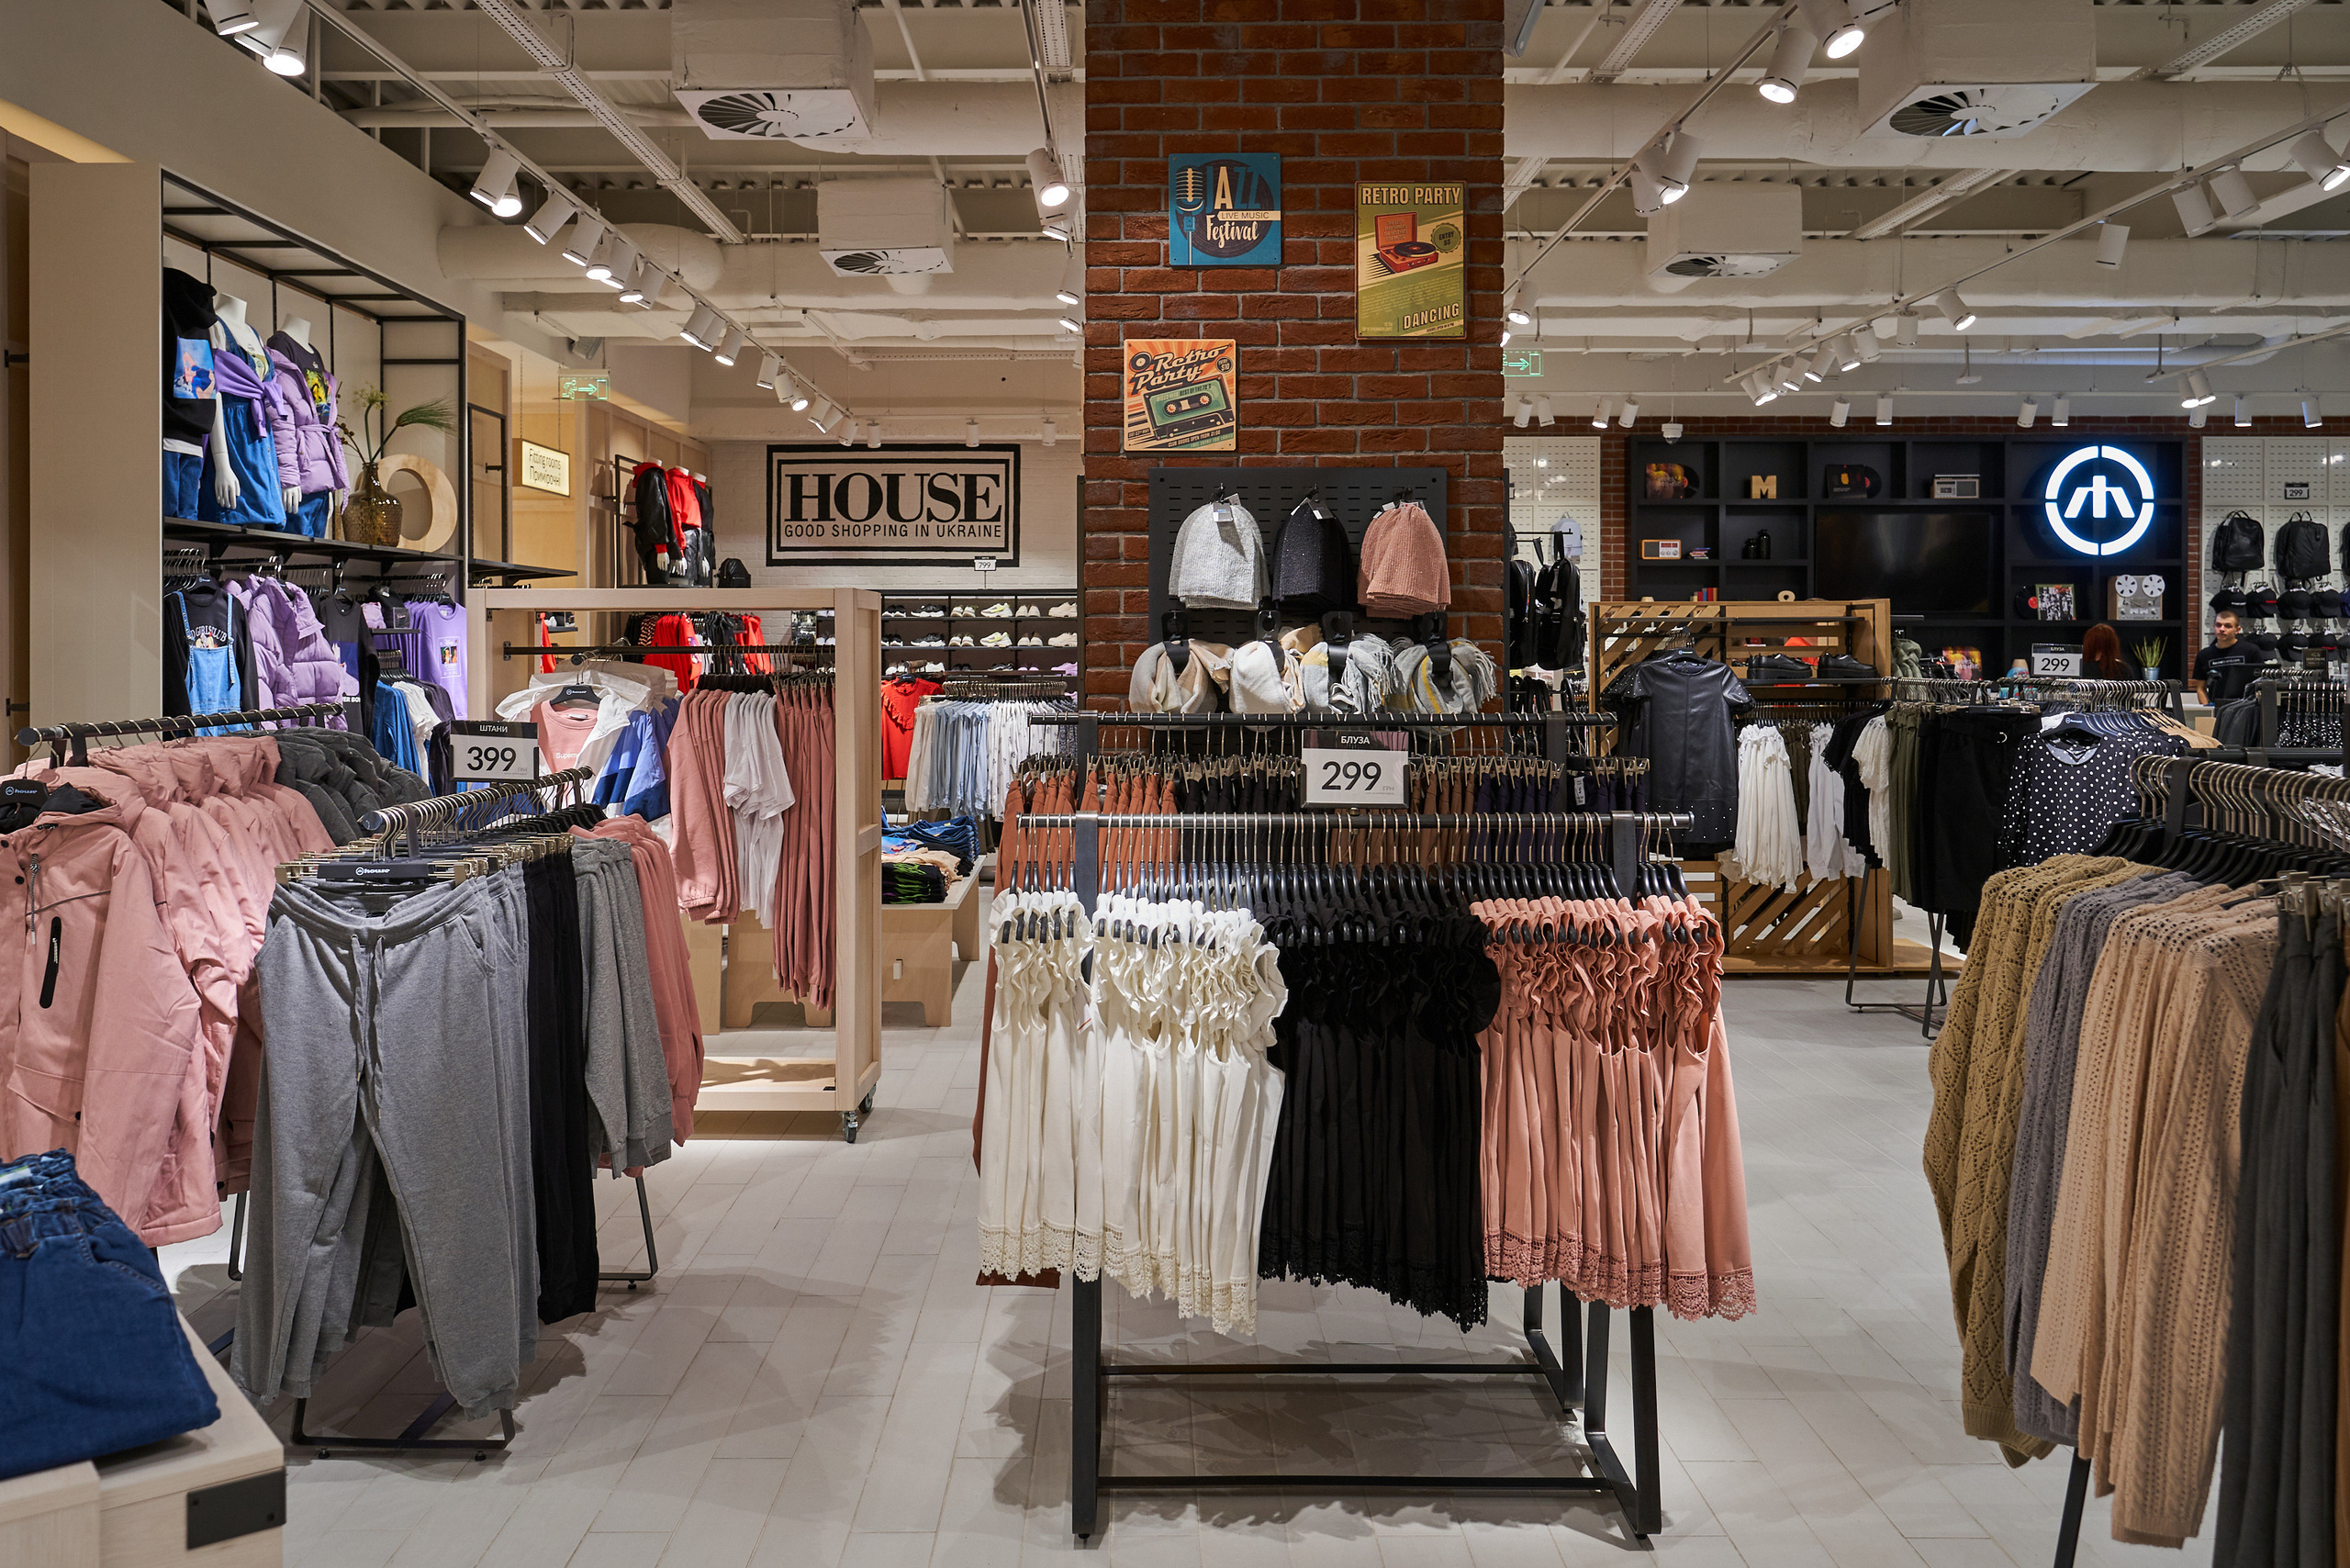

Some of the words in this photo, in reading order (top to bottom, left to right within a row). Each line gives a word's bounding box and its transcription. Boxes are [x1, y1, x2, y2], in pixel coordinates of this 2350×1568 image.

[1361, 186, 1409, 205] RETRO
[1415, 186, 1460, 205] PARTY
[1205, 214, 1259, 249] Festival
[1403, 302, 1460, 330] DANCING
[1153, 345, 1229, 372] Retro
[1135, 365, 1202, 390] Party
[530, 448, 545, 469] Fitting
[546, 456, 562, 470] rooms
[784, 472, 1002, 523] HOUSE
[1751, 475, 1777, 499] M
[785, 524, 825, 538] GOOD
[832, 524, 908, 538] SHOPPING
[915, 524, 930, 537] IN
[936, 524, 1002, 538] UKRAINE
[2041, 657, 2070, 671] 299
[479, 724, 509, 733] ШТАНИ
[1340, 735, 1371, 745] БЛУЗА
[466, 746, 517, 772] 399
[1322, 761, 1382, 791] 299
